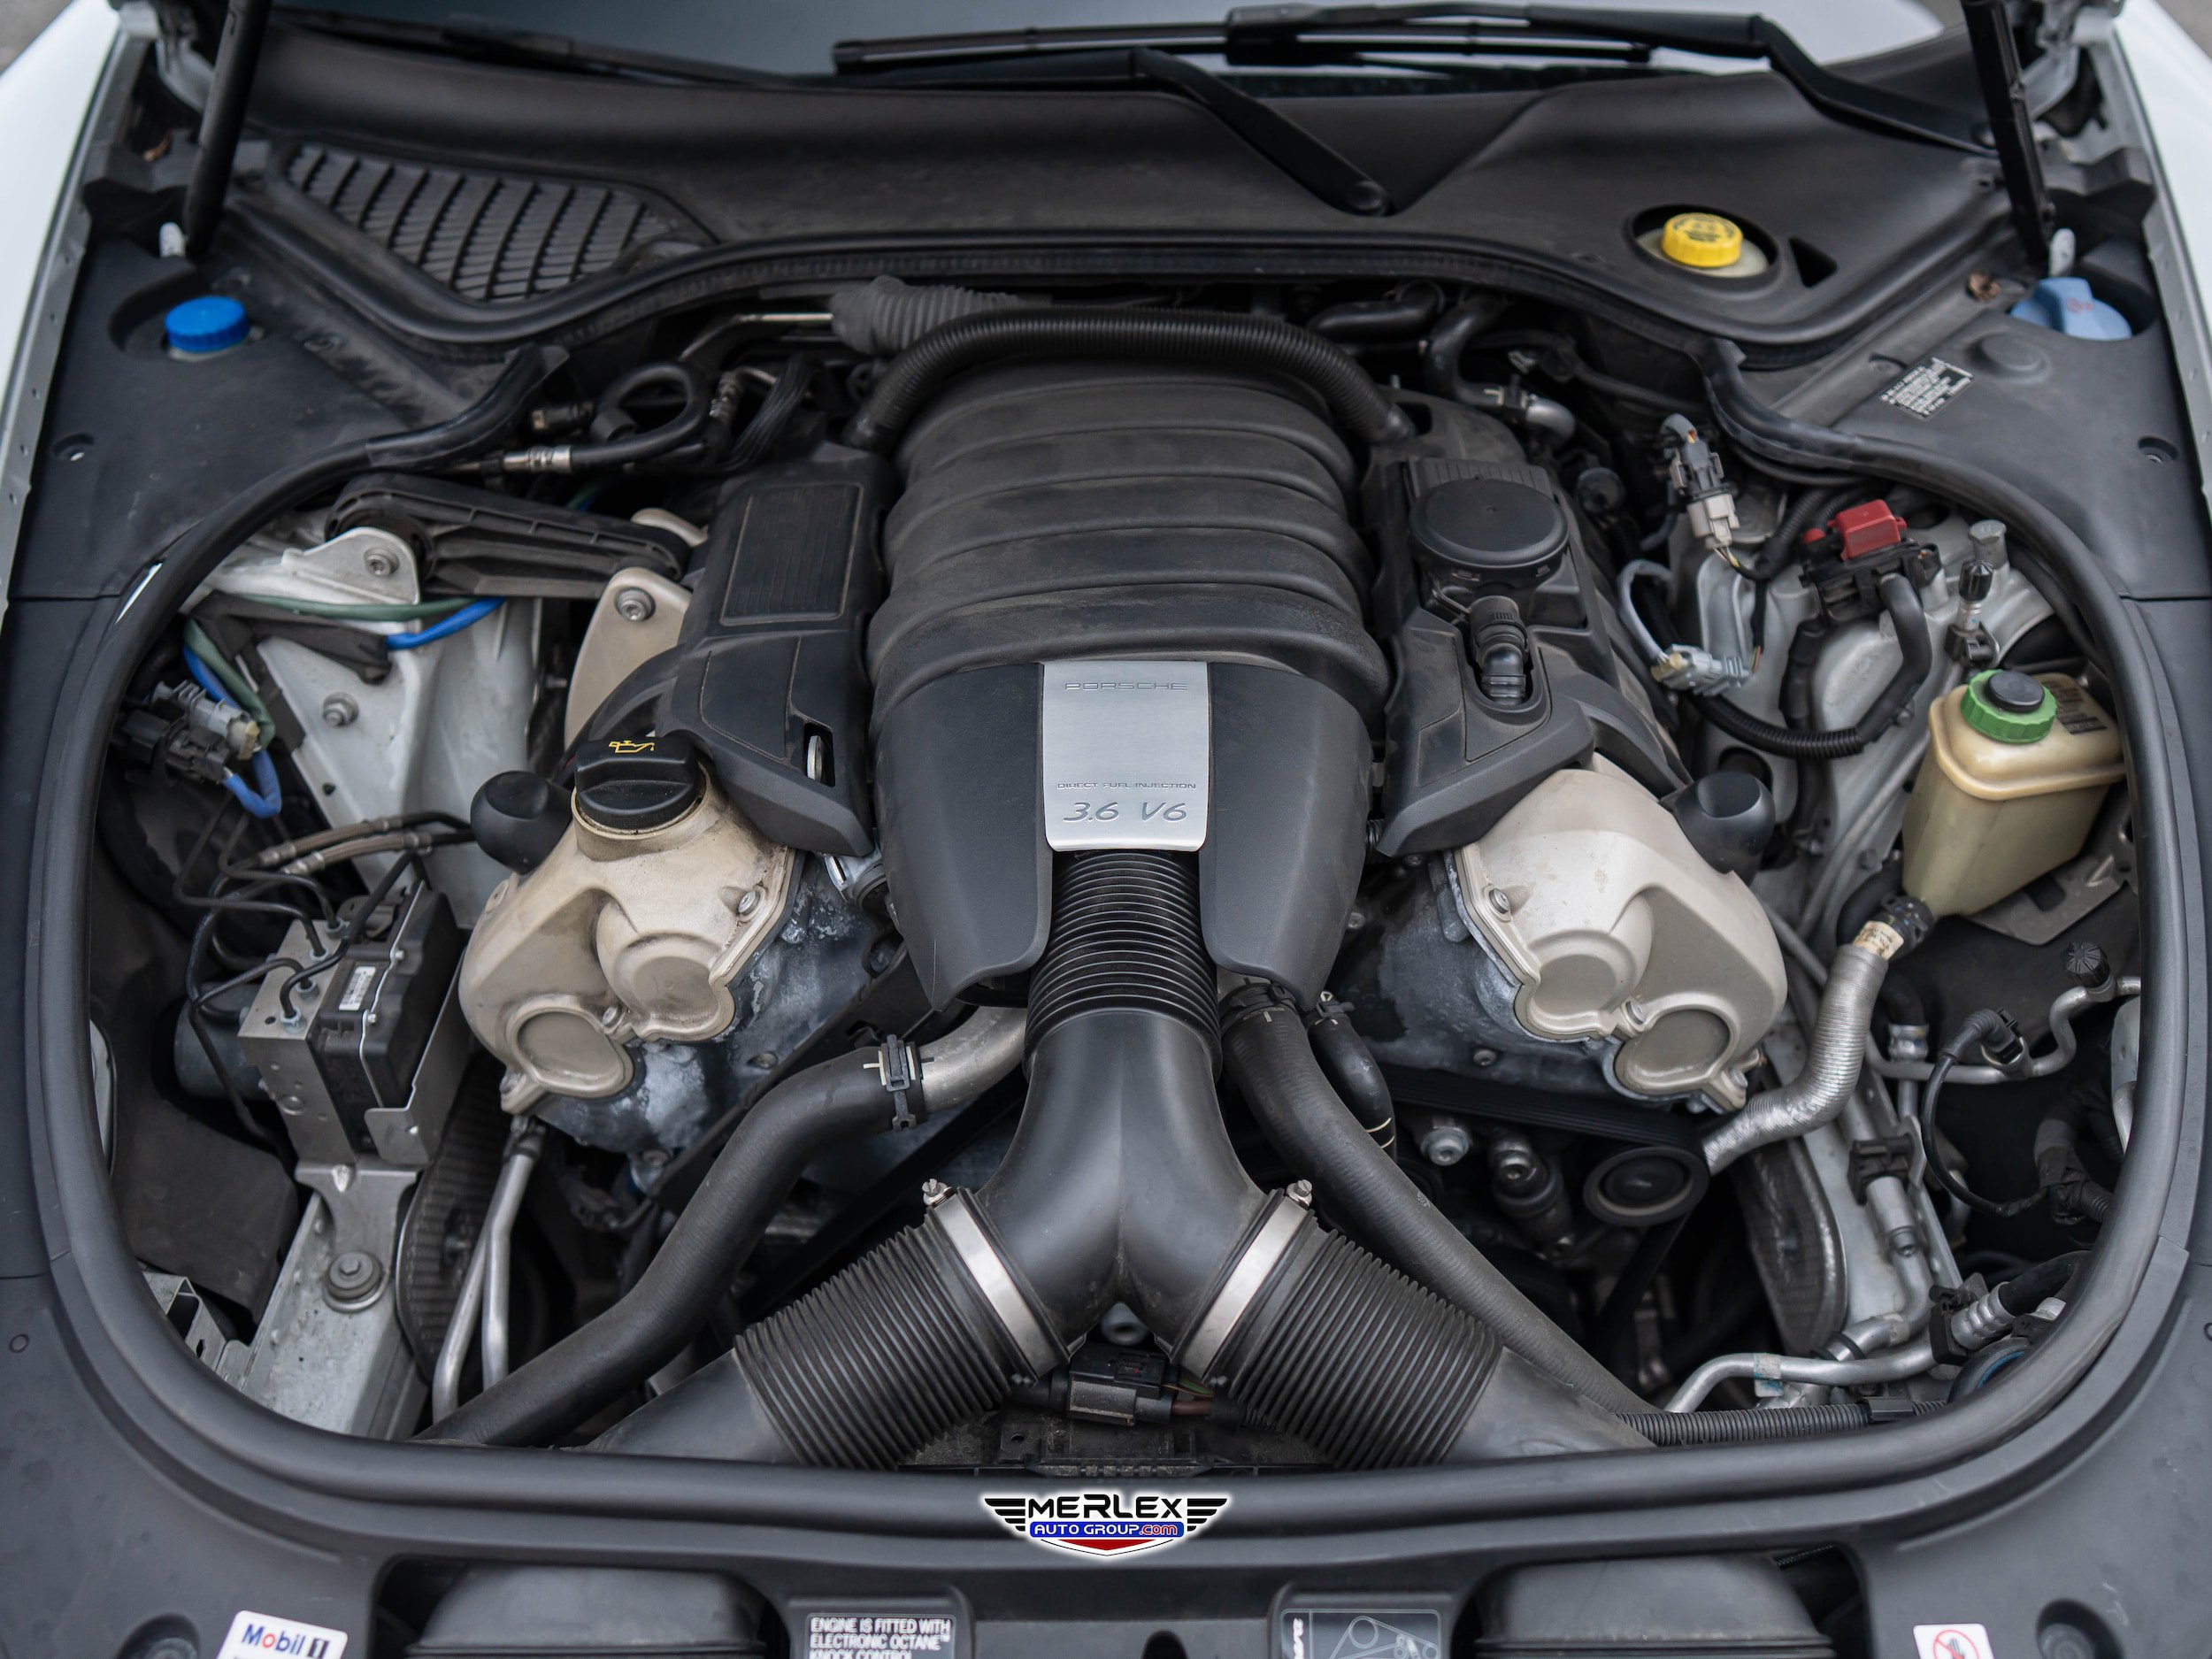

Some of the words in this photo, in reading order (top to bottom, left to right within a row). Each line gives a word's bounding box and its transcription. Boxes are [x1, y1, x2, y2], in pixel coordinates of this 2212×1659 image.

[1064, 682, 1188, 691] PORSCHE
[1063, 802, 1119, 822] 3.6
[1141, 802, 1187, 822] V6
[810, 1617, 857, 1633] ENGINE
[859, 1617, 873, 1633] IS
[874, 1618, 918, 1634] FITTED
[918, 1618, 951, 1635] WITH
[241, 1624, 306, 1655] Mobil
[810, 1632, 887, 1648] ELECTRONIC
